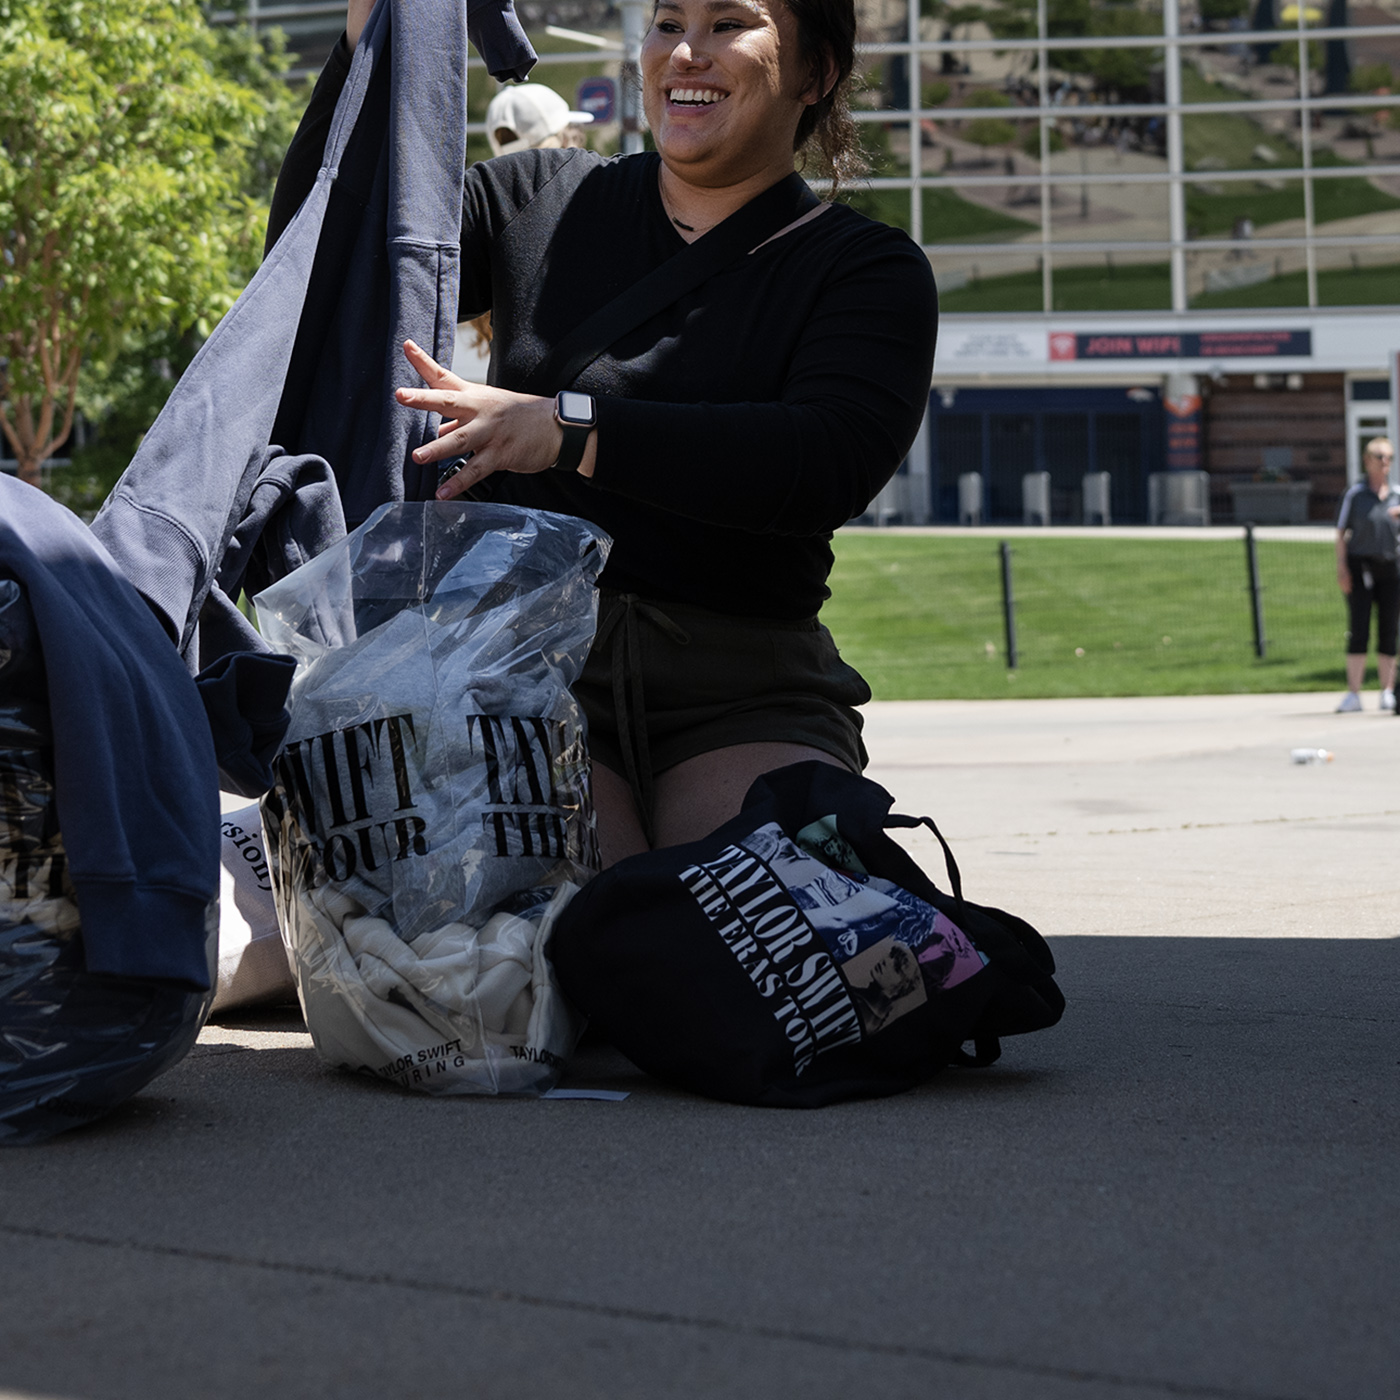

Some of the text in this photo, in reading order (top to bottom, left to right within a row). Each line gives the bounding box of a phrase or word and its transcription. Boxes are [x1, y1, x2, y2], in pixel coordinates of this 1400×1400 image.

[678, 864, 731, 922] THE
[717, 917, 783, 998] ERAS
[701, 844, 813, 964] TAYLOR
[417, 1039, 462, 1063] SWIFT
